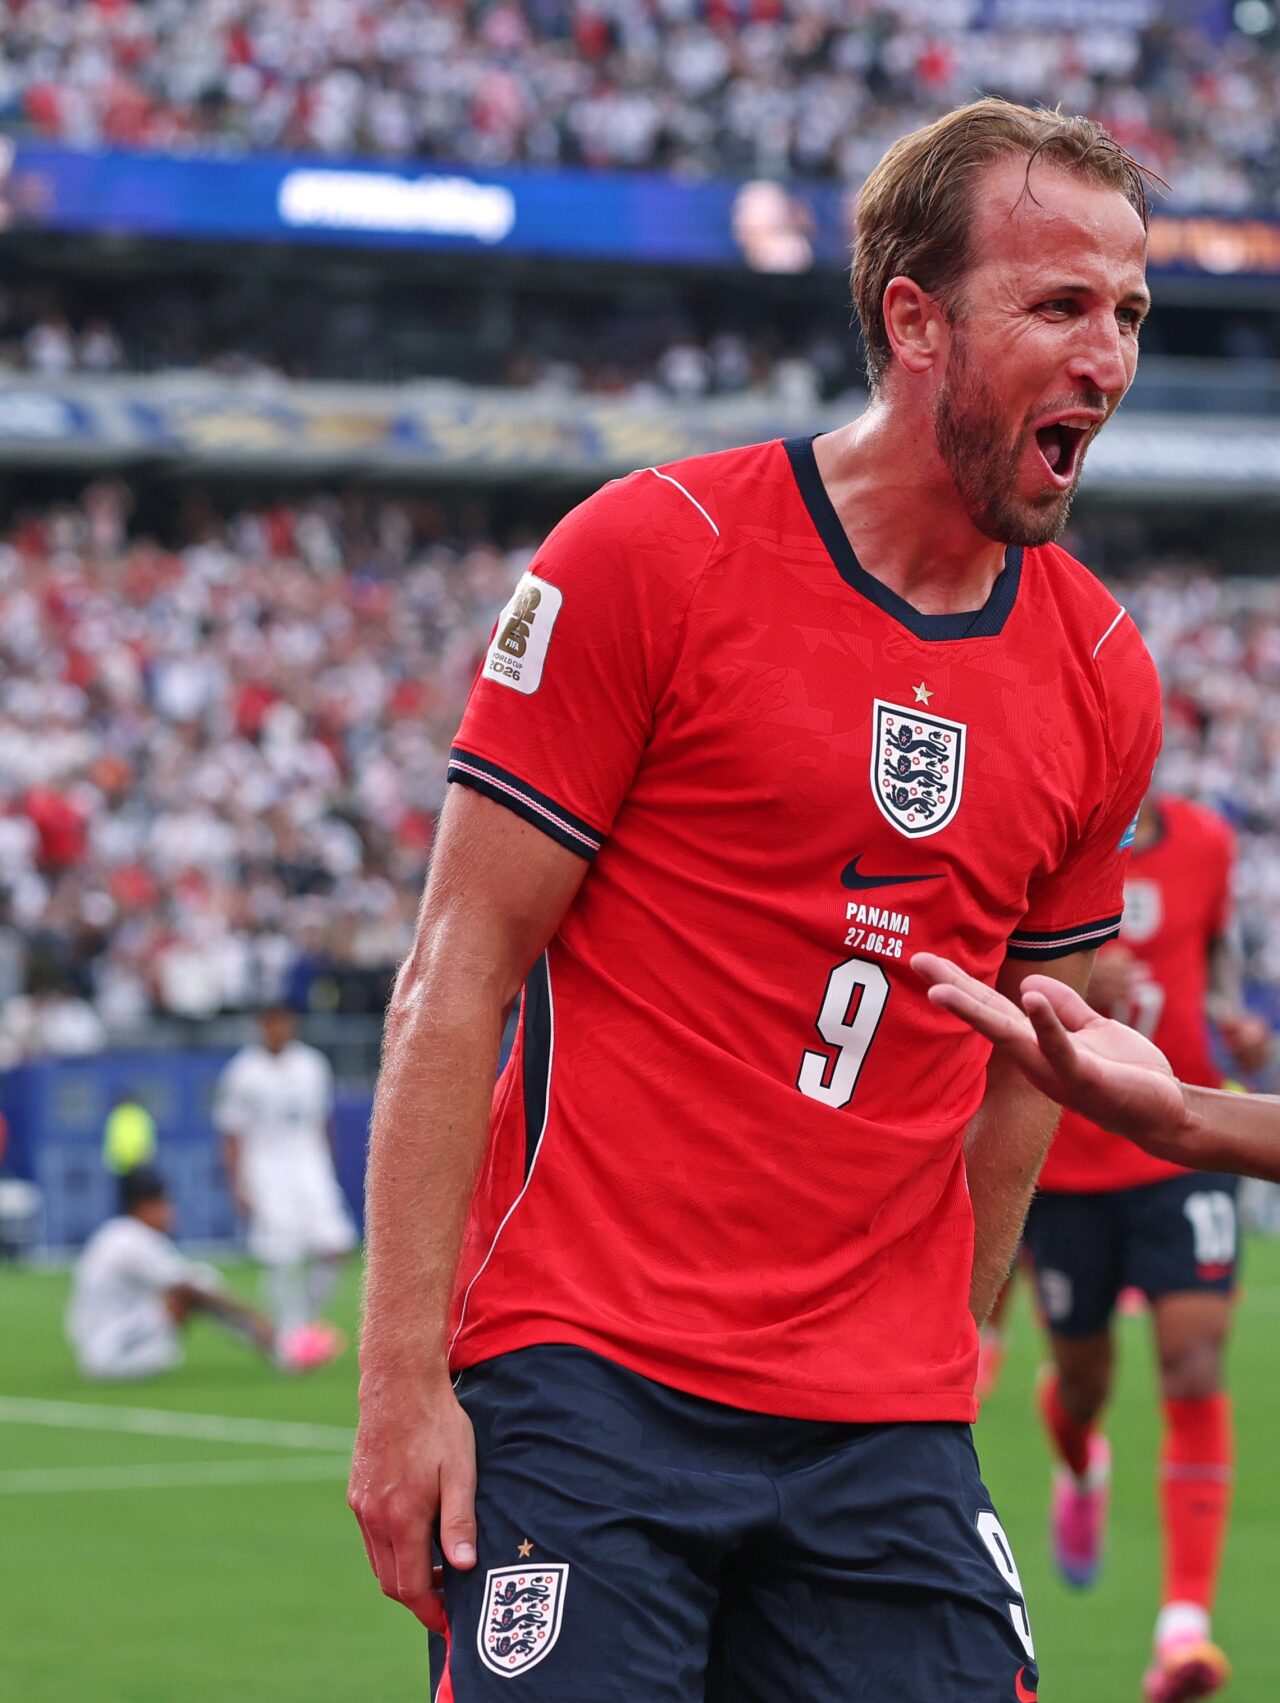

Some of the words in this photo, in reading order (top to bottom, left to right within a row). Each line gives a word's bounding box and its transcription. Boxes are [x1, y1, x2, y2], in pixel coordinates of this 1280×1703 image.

[493, 652, 513, 665] ORLD
[512, 659, 523, 669] CUP
[504, 638, 520, 652] FIFA
[846, 902, 910, 935] PANAMA
[844, 927, 903, 958] 27.06.26
[796, 956, 891, 1109] 9
[973, 1510, 1036, 1663] 9
